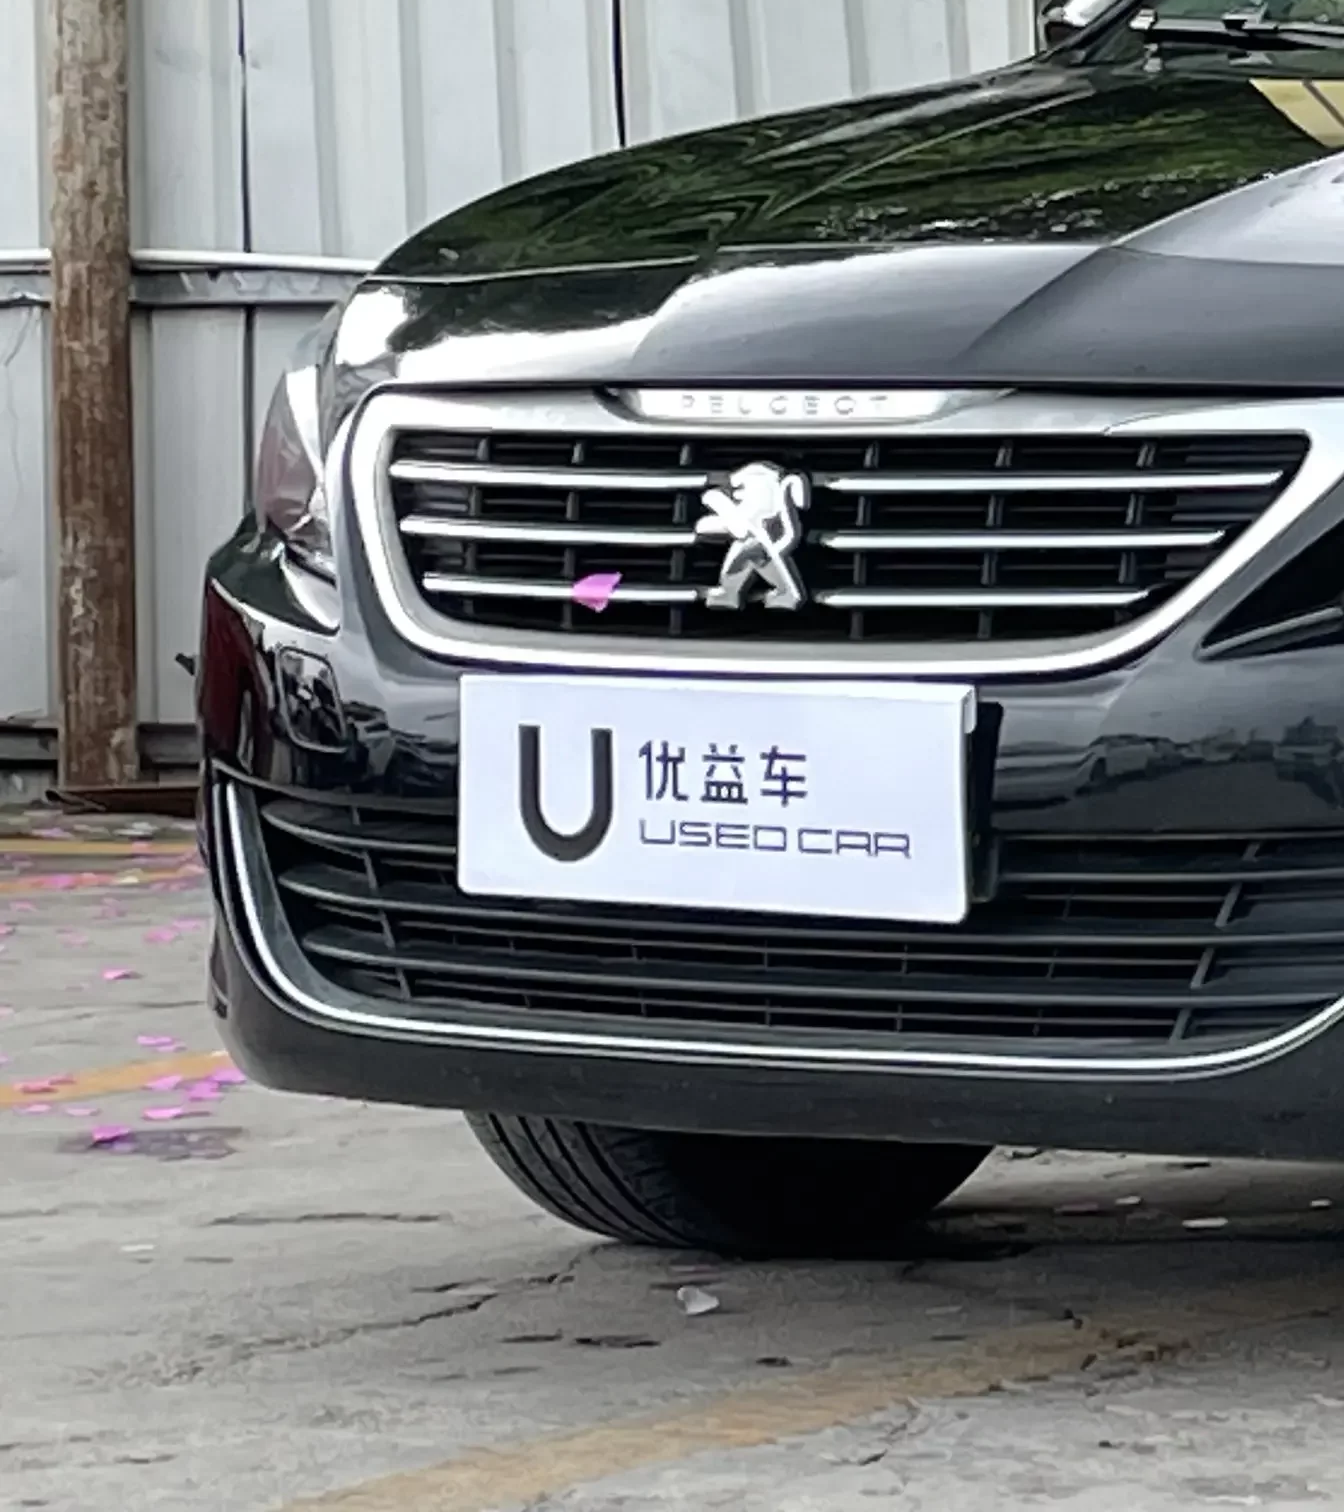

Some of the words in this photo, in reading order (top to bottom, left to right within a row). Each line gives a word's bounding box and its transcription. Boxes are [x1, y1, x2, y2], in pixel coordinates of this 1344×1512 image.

[638, 740, 808, 808] 优益车
[639, 819, 788, 852] USED
[797, 827, 911, 859] CAR
